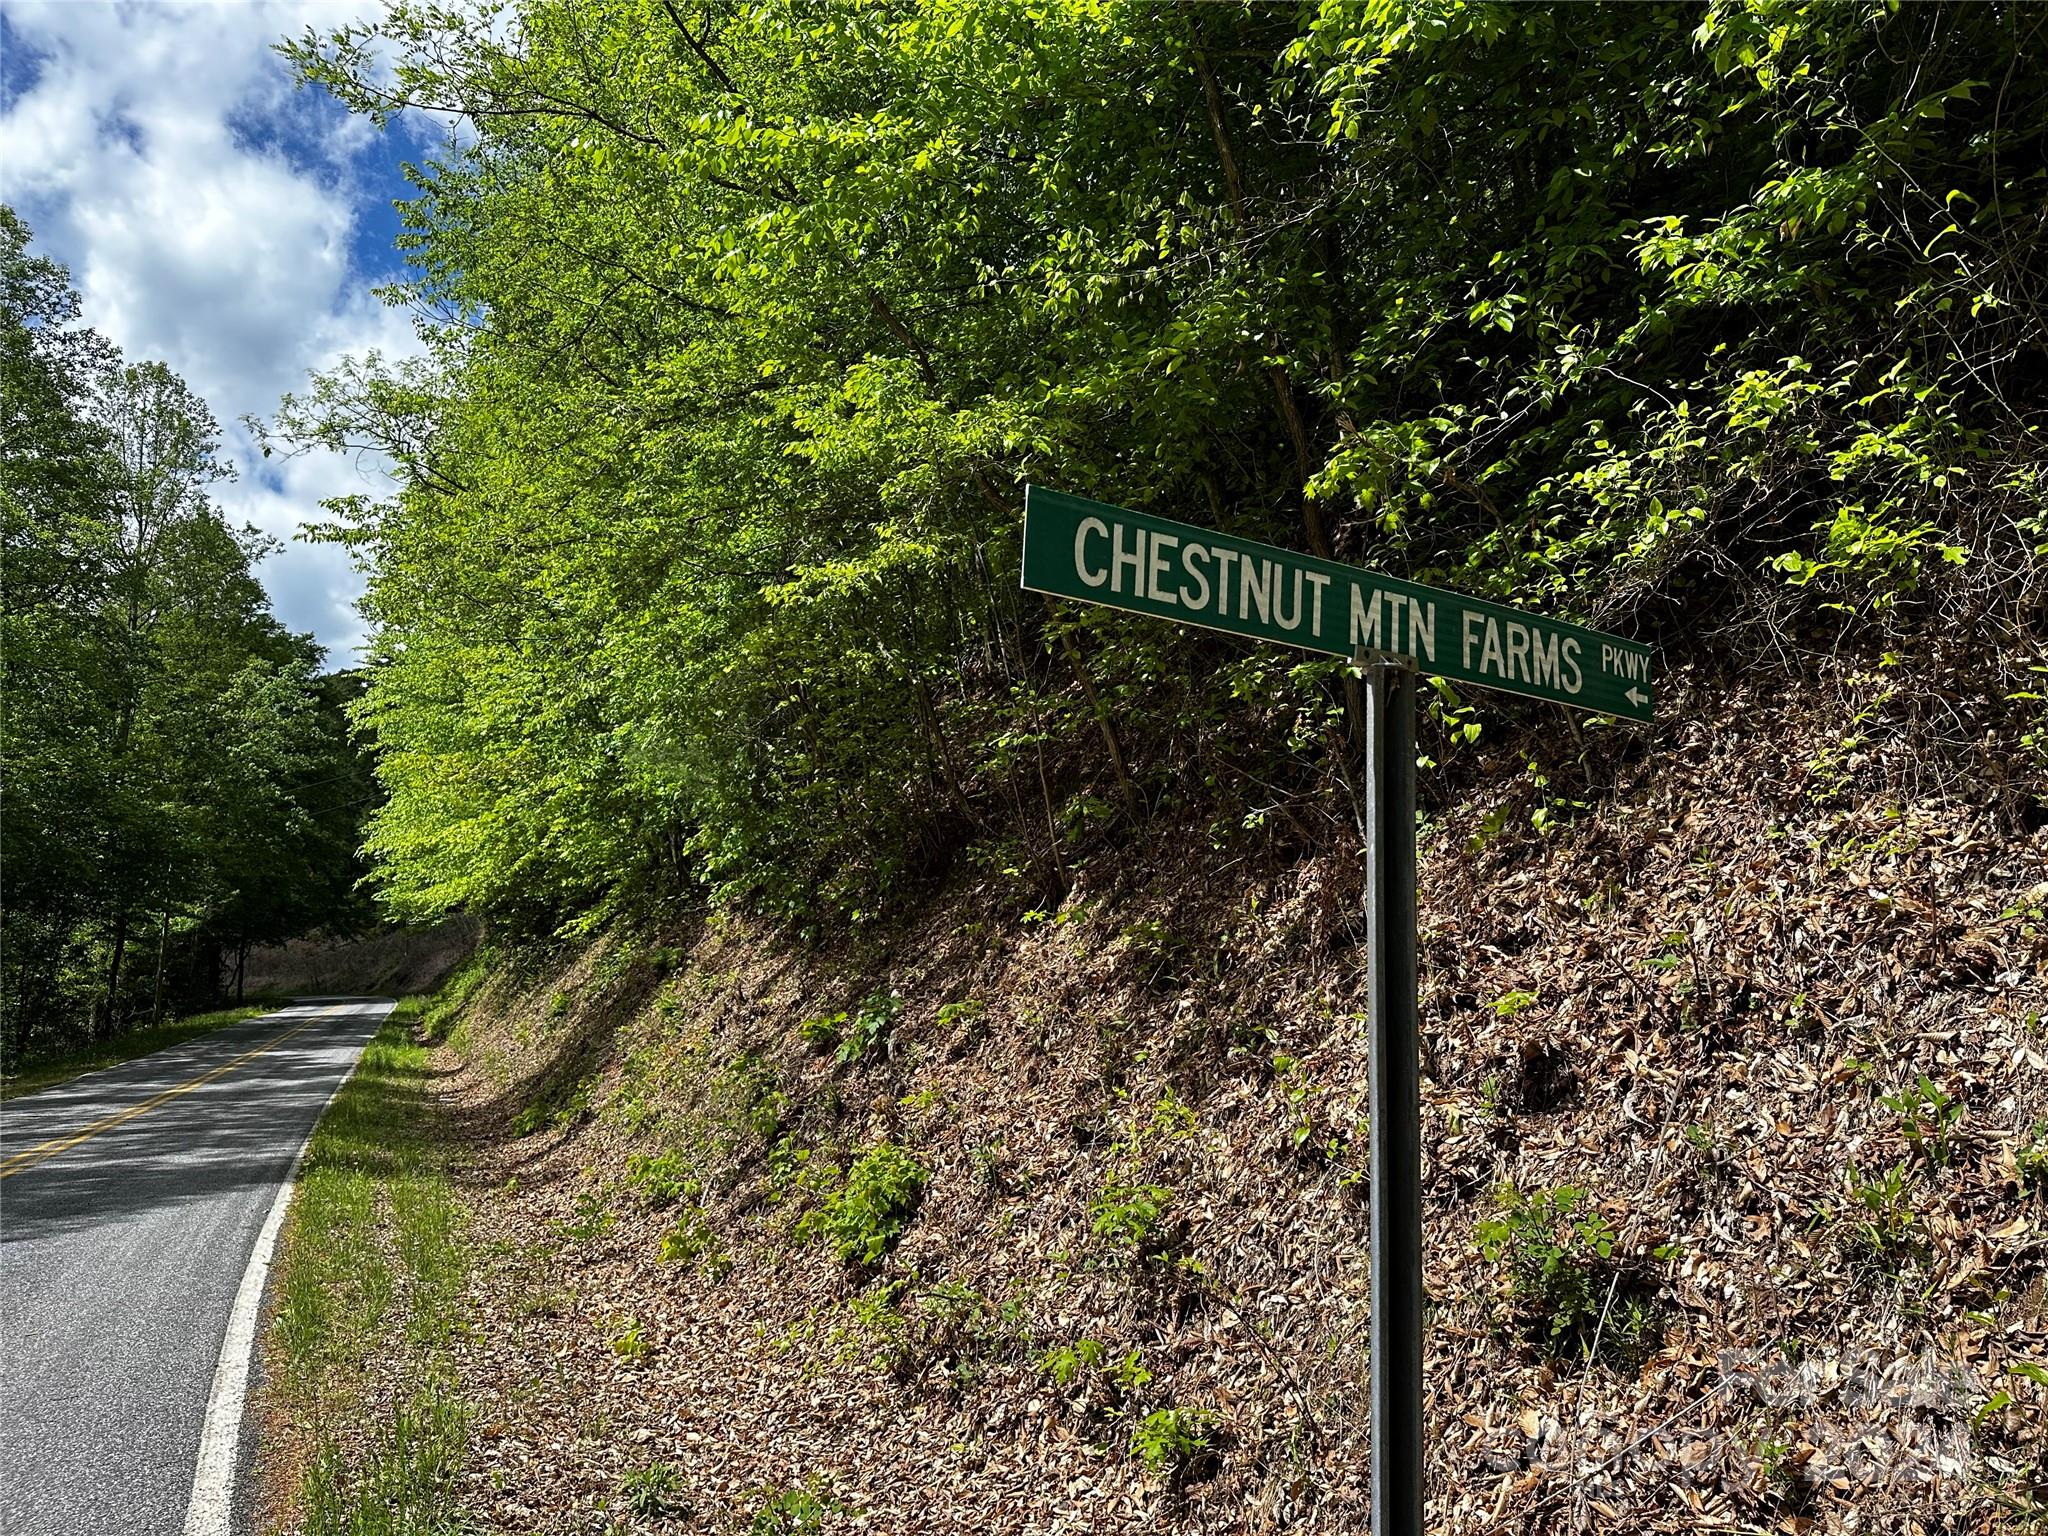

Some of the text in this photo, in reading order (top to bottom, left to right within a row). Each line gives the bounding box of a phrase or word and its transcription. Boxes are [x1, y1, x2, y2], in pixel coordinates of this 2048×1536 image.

[1075, 518, 1582, 694] CHESTNUT MTN FARMS
[1601, 644, 1650, 682] PKWY
